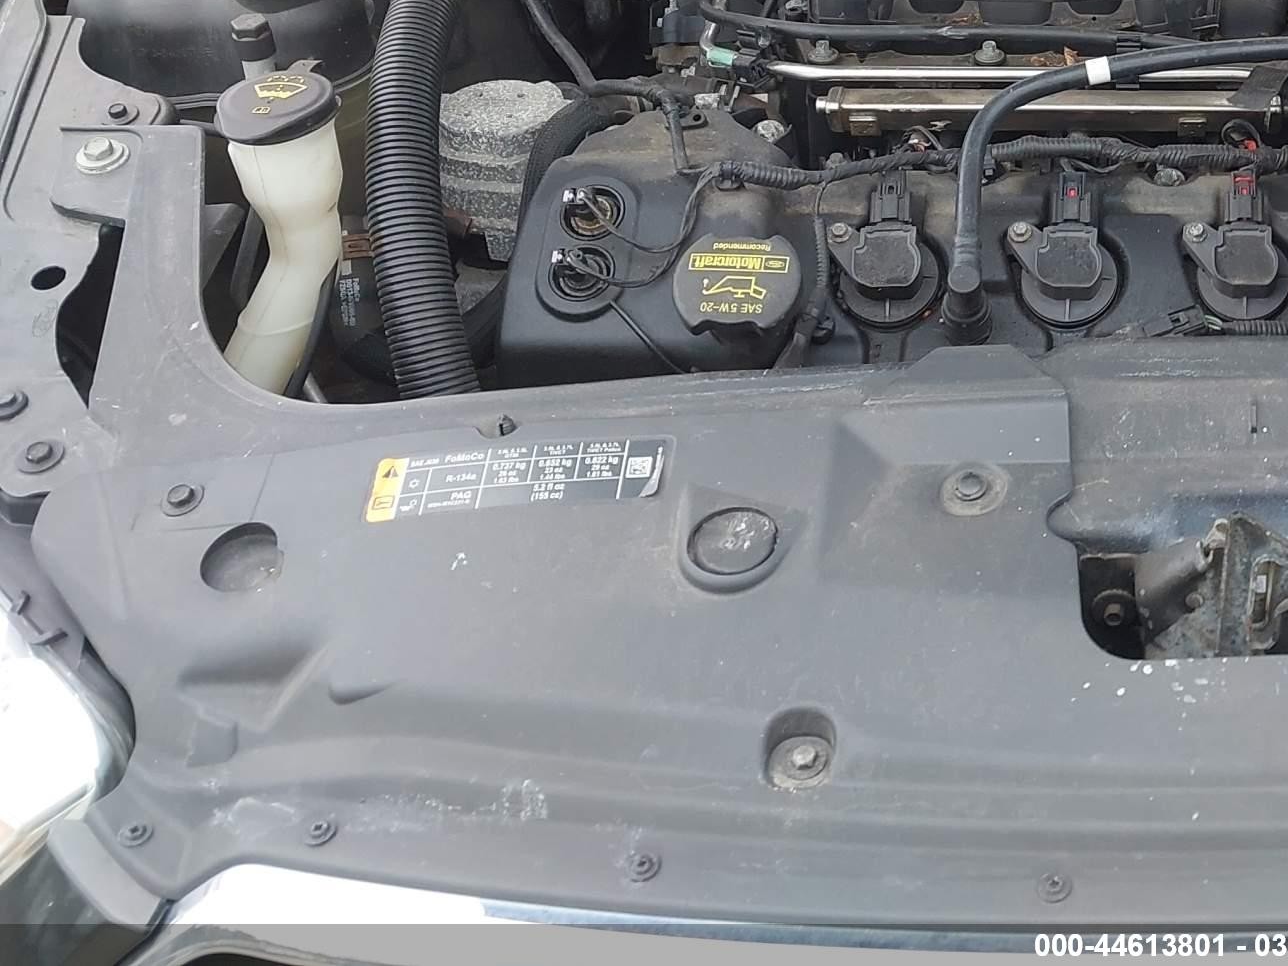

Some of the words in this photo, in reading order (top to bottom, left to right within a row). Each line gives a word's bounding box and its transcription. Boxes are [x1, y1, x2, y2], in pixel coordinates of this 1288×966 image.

[712, 242, 772, 252] Recommended
[694, 255, 762, 270] Motorcraft
[700, 301, 738, 313] 5W-20
[740, 303, 763, 314] SAE
[450, 490, 472, 500] PAG
